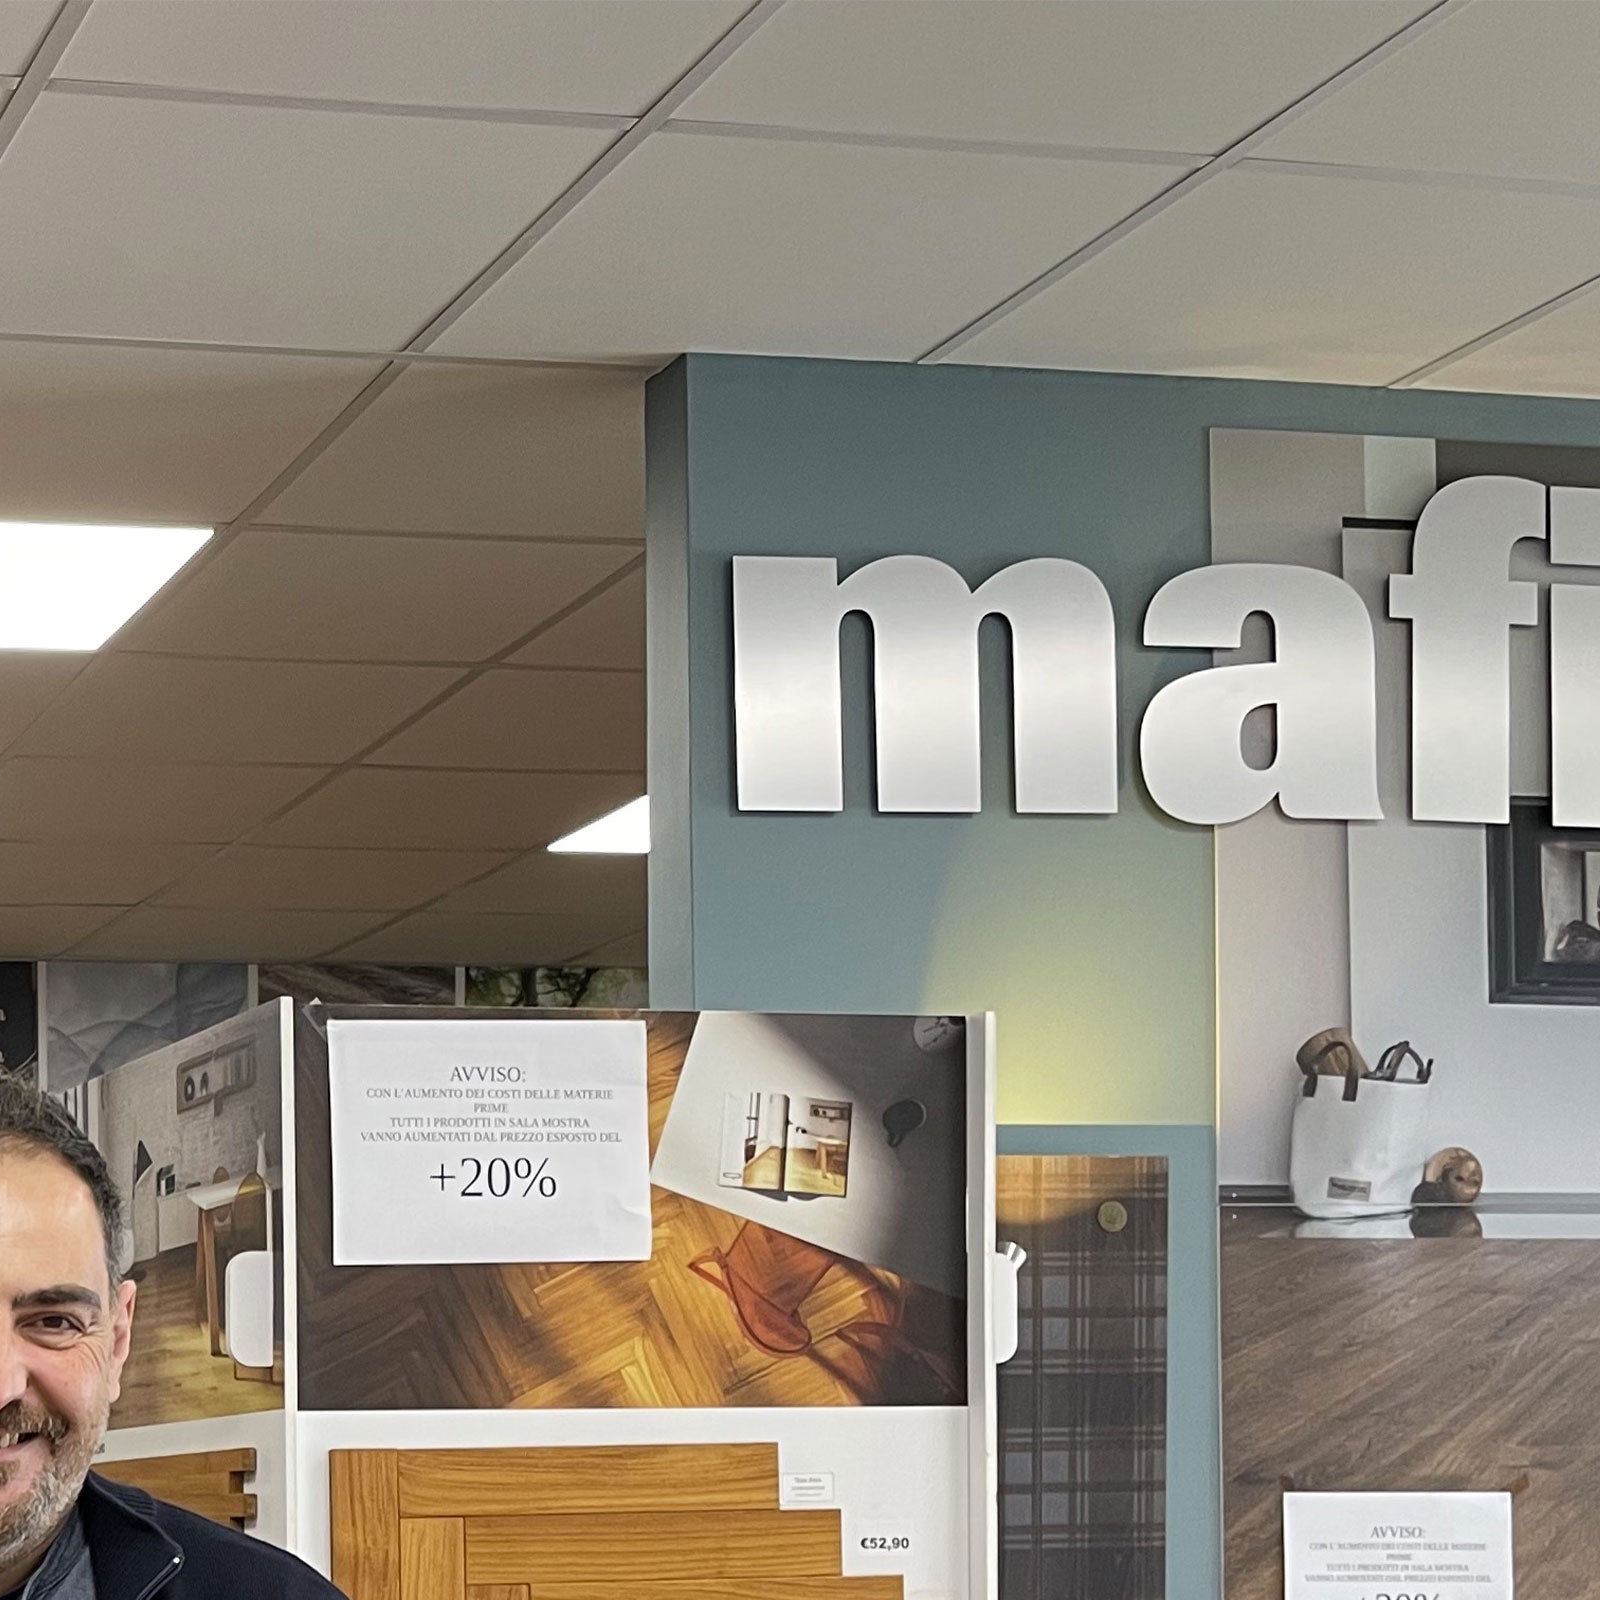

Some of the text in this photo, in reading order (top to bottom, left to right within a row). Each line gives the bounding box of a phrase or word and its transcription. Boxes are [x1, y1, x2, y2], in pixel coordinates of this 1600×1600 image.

[449, 1066, 527, 1083] AVVISO:
[366, 1088, 392, 1100] CON
[466, 1088, 485, 1100] DEI
[487, 1088, 521, 1100] COSTI
[524, 1088, 561, 1100] DELLE
[563, 1088, 614, 1100] MATERIE
[473, 1103, 508, 1114] PRIME
[389, 1117, 424, 1128] TUTTI
[433, 1117, 491, 1128] PRODOTTI
[494, 1117, 507, 1128] IN
[509, 1117, 539, 1128] SALA
[542, 1117, 590, 1128] MOSTRA
[360, 1131, 622, 1143] VANNO AUMENTATI DAL PREZZO ESPOSTO DEL
[429, 1157, 557, 1198] +20%
[860, 1537, 910, 1551] €52,90
